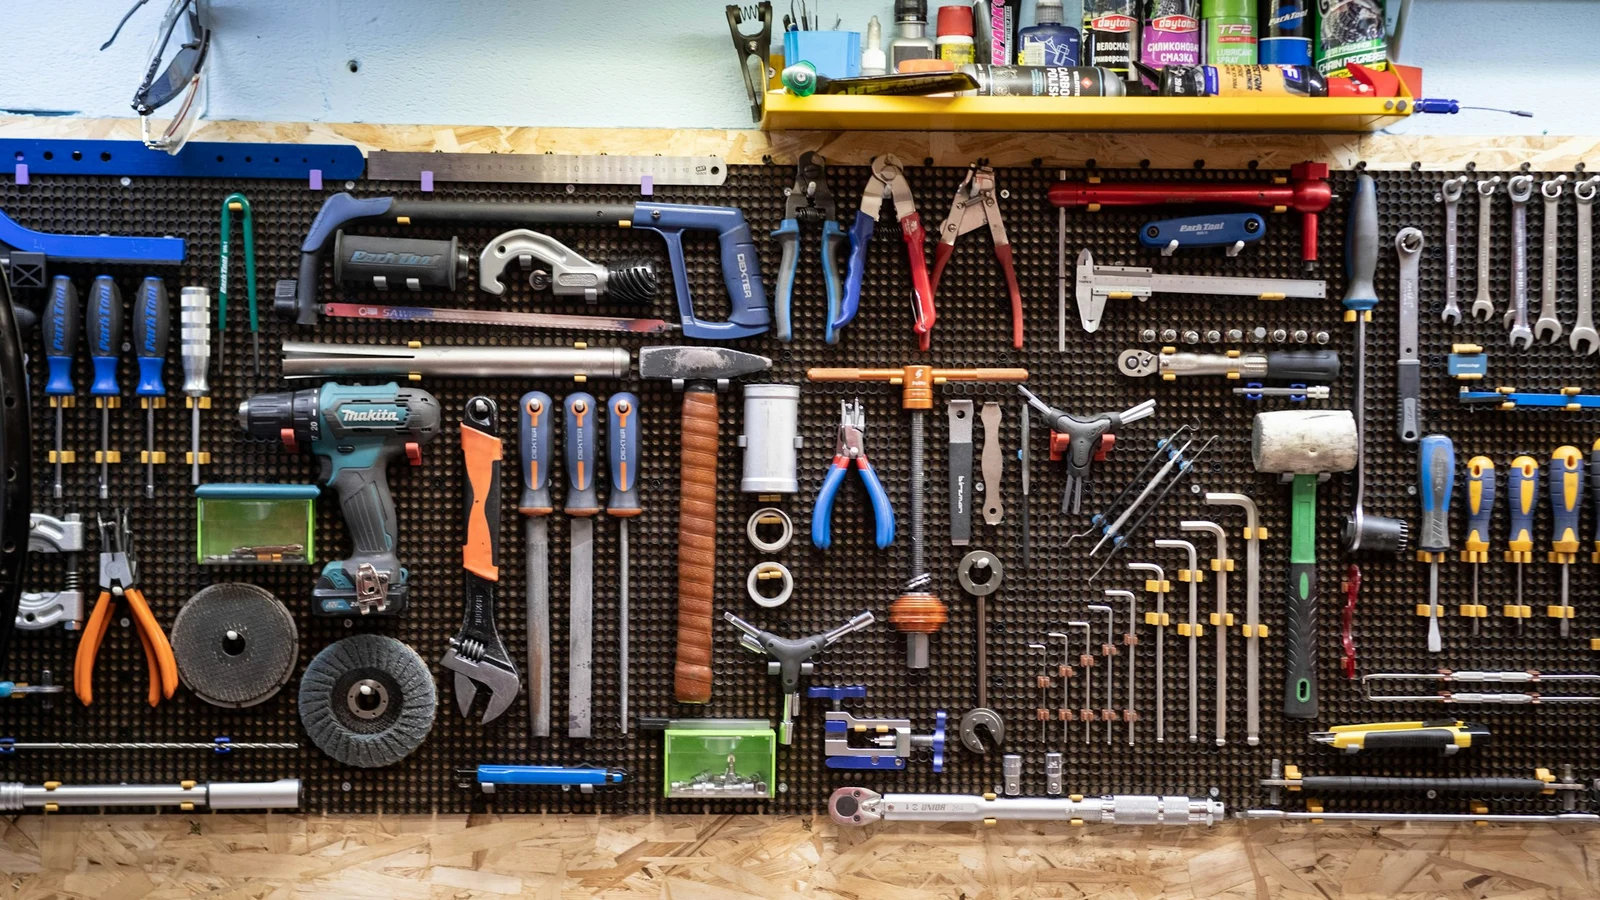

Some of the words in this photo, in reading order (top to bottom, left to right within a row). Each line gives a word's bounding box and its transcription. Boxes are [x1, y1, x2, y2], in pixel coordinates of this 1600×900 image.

[1098, 18, 1131, 29] dayton
[1158, 18, 1196, 29] daytona
[1217, 24, 1252, 35] TF2
[1096, 41, 1130, 51] ВЕЛОСМАЗ
[1160, 53, 1194, 63] СМАЗКА
[1058, 67, 1070, 97] CARBO
[737, 253, 752, 298] DEXTER
[310, 421, 318, 431] 20
[921, 803, 947, 811] UNIOR
